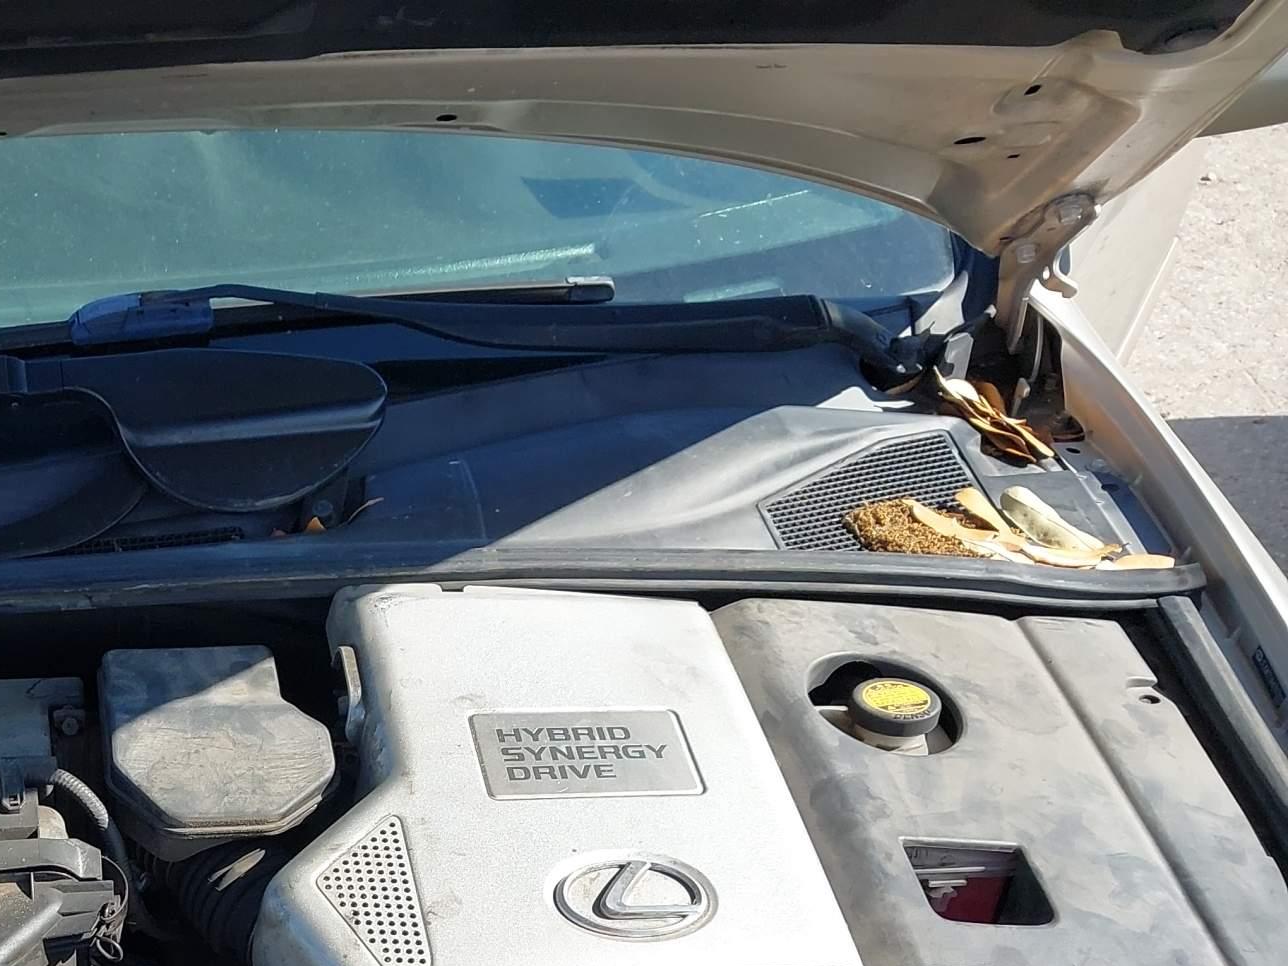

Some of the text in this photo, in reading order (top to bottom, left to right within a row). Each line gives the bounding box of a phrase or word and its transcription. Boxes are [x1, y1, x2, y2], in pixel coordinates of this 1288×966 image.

[496, 726, 631, 743] HYBRID
[501, 744, 667, 762] SYNERGY
[507, 764, 617, 781] DRIVE
